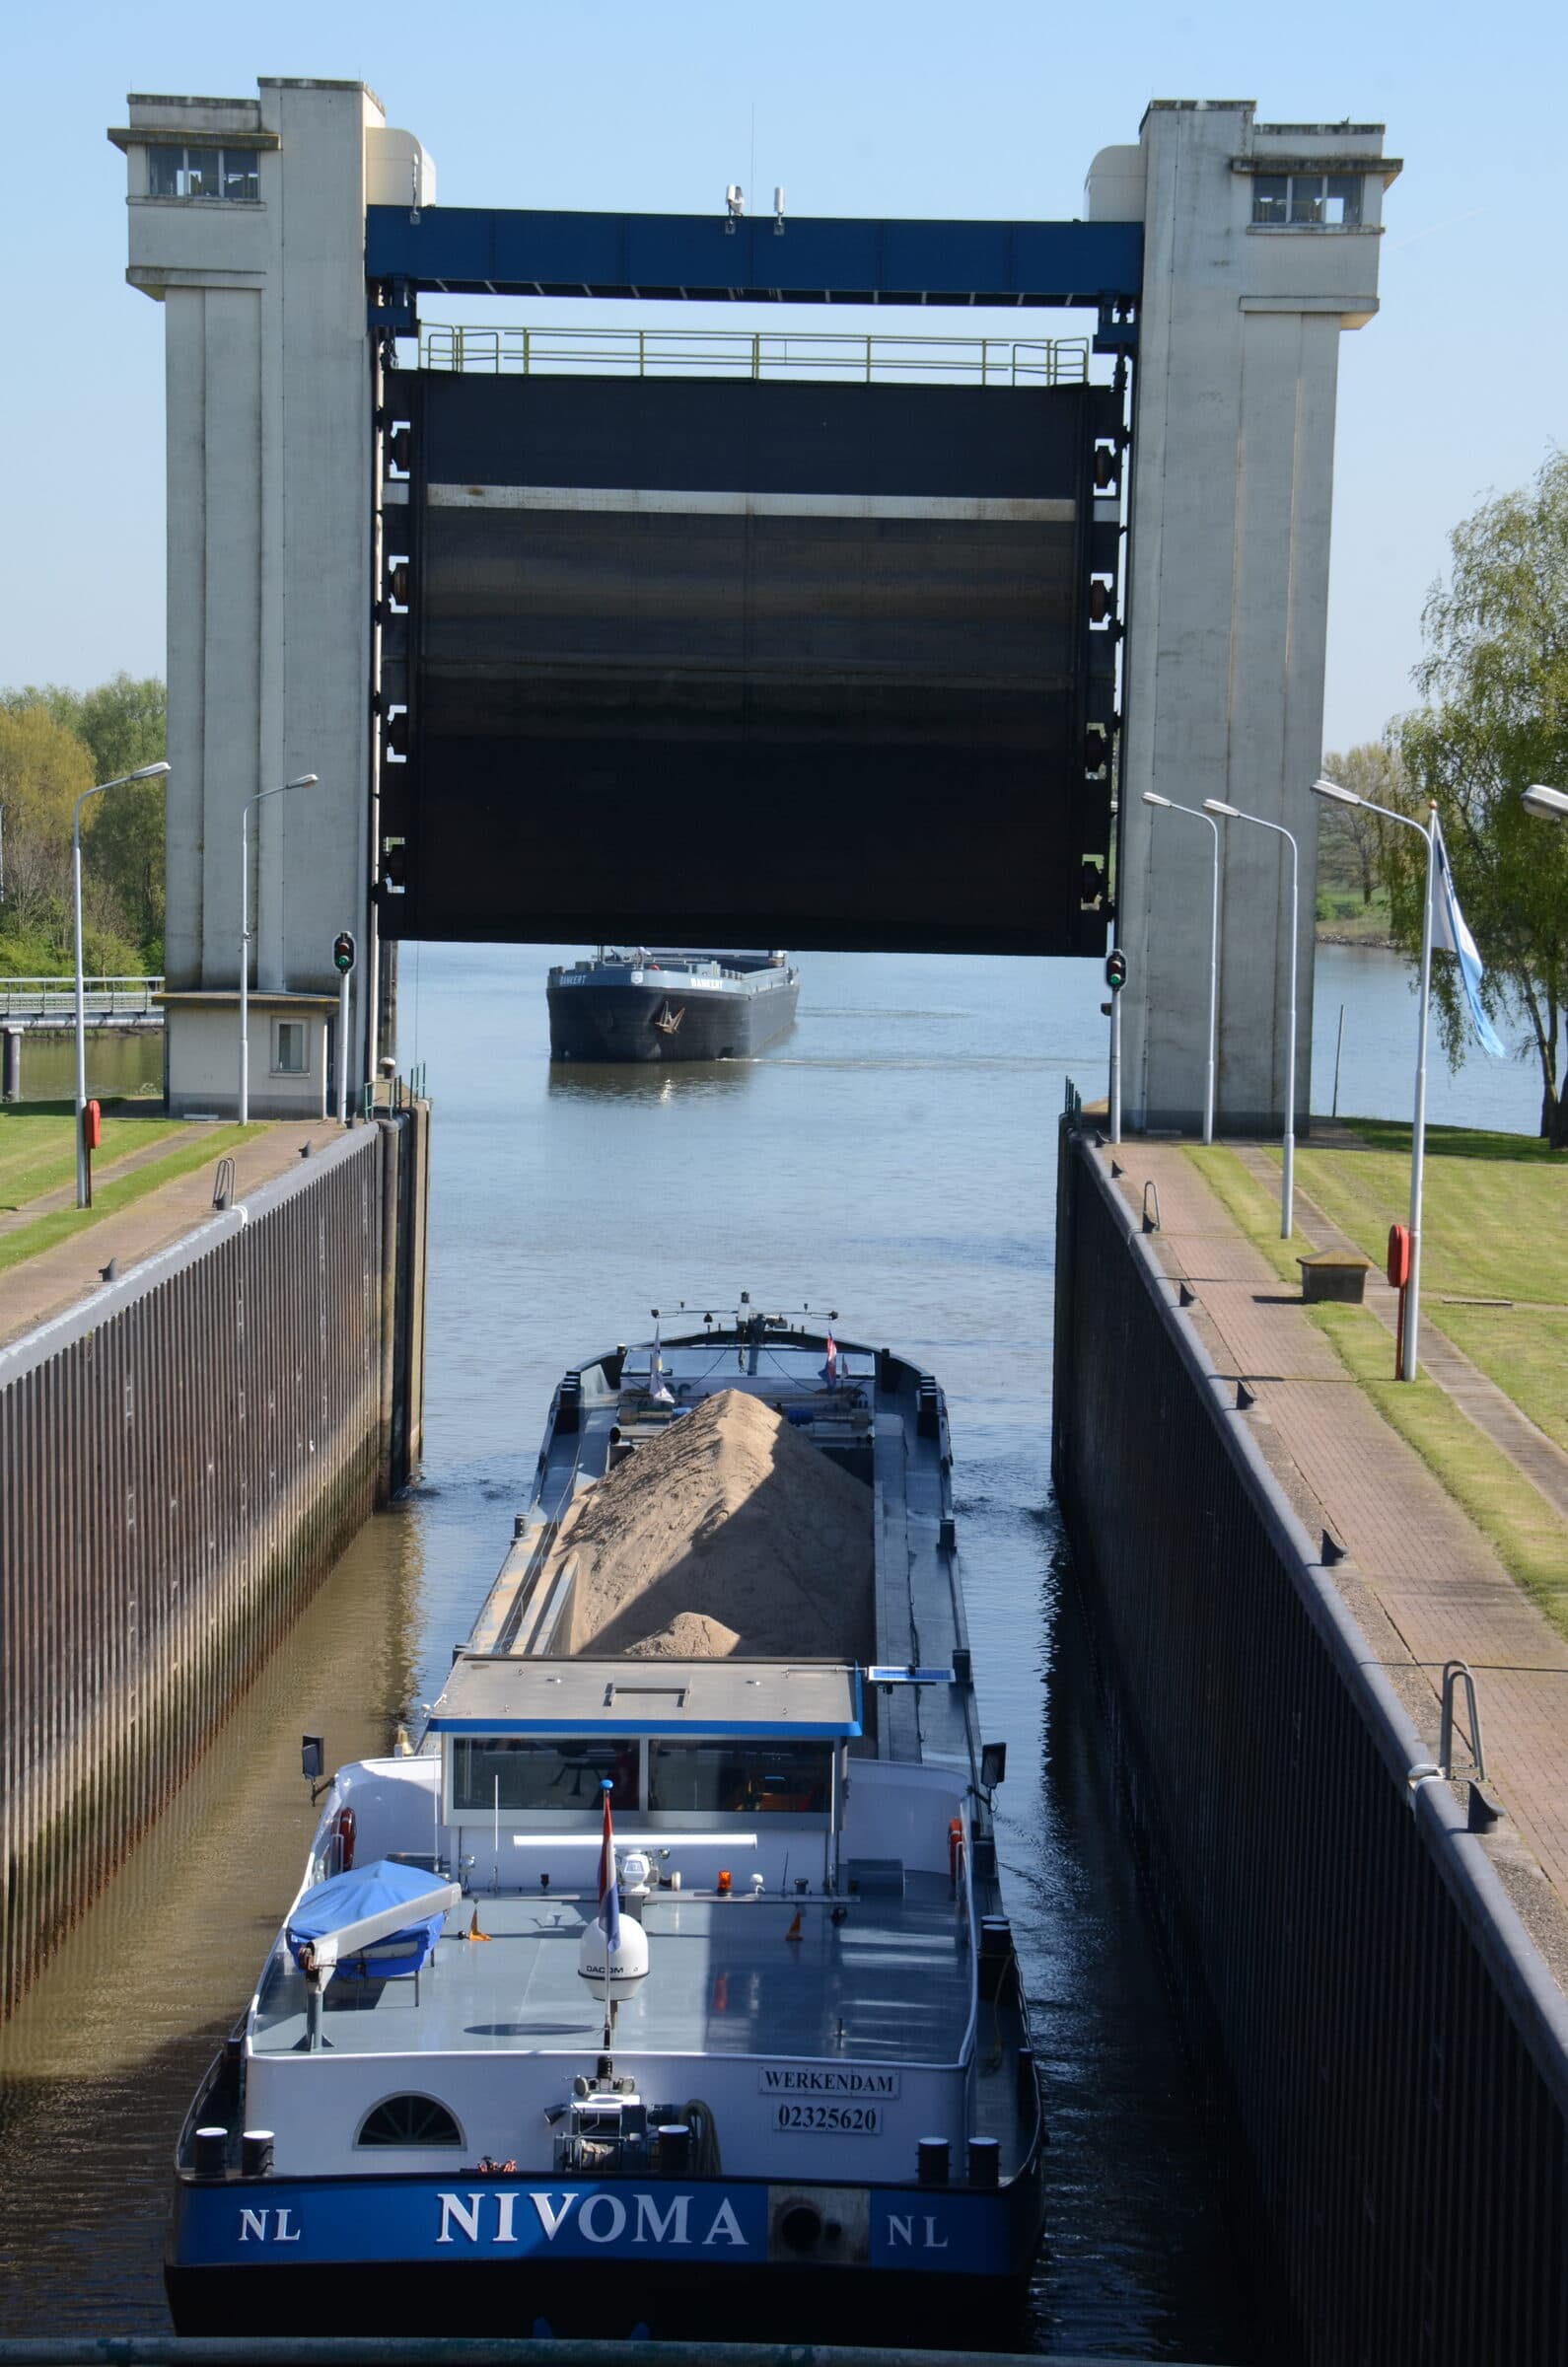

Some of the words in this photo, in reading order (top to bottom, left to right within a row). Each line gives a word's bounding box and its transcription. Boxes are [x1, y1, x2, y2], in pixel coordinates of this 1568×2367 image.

[765, 2071, 893, 2092] WERKENDAM
[778, 2104, 877, 2130] 02325620
[238, 2208, 301, 2241] NL
[436, 2192, 749, 2246] NIVOMA
[886, 2215, 949, 2247] NL
